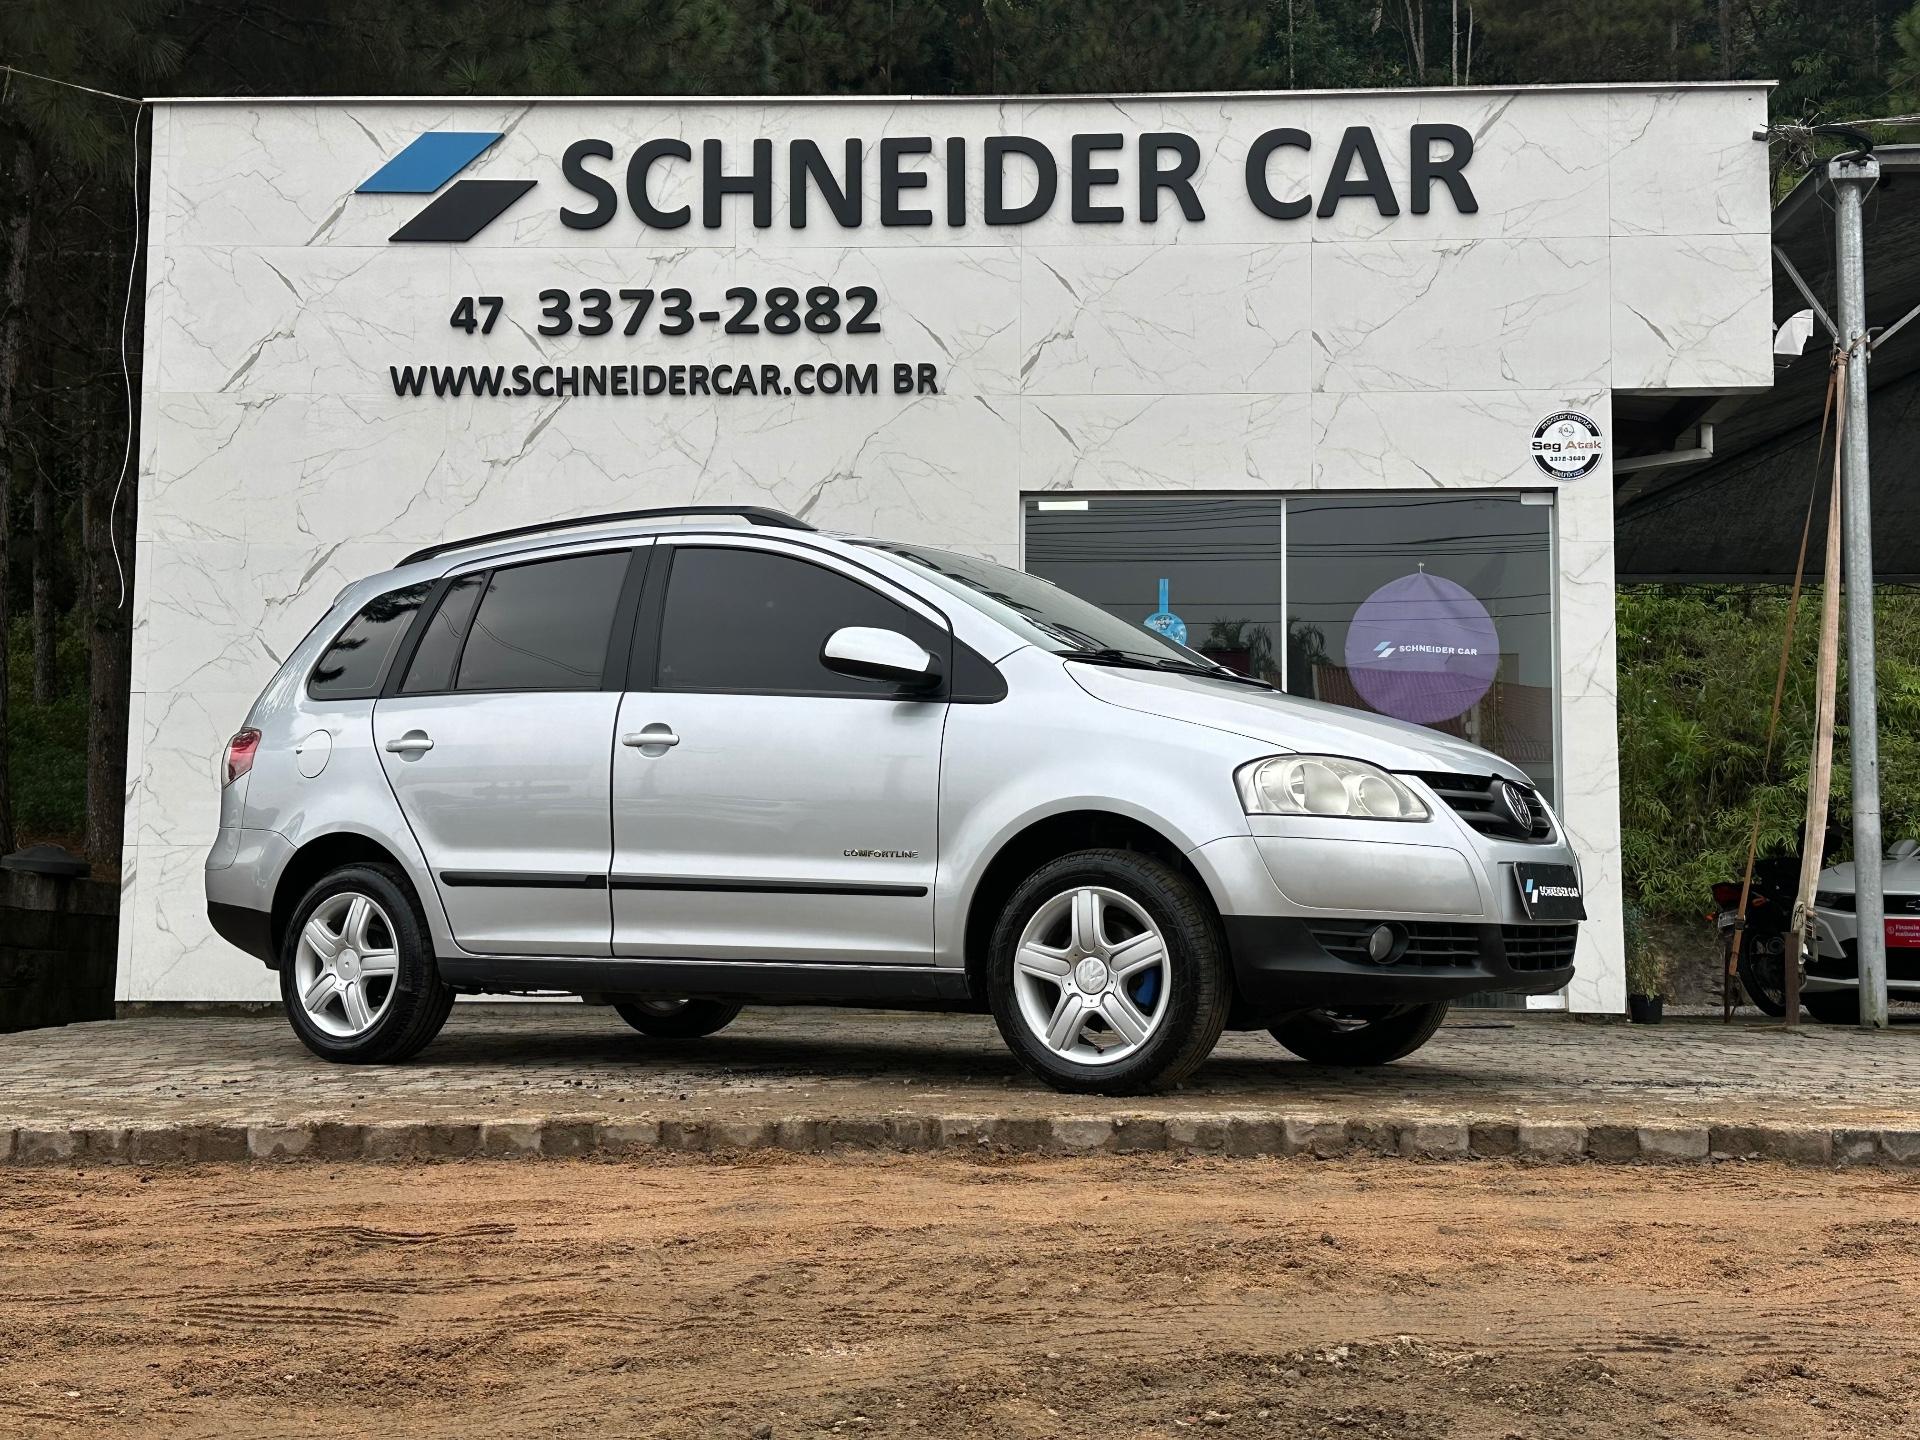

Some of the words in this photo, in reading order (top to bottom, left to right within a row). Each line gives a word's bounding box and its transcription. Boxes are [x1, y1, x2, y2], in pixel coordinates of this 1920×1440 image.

[559, 132, 1206, 231] SCHNEIDER
[1244, 122, 1480, 220] CAR
[449, 296, 504, 335] 47
[536, 285, 882, 337] 3373-2882
[389, 362, 879, 397] WWW.SCHNEIDERCAR.COM
[893, 362, 940, 395] BR
[1531, 441, 1562, 453] Seg
[1399, 644, 1455, 655] SCHNEIDER
[1457, 647, 1478, 656] CAR
[843, 849, 919, 859] COMFORTLINE
